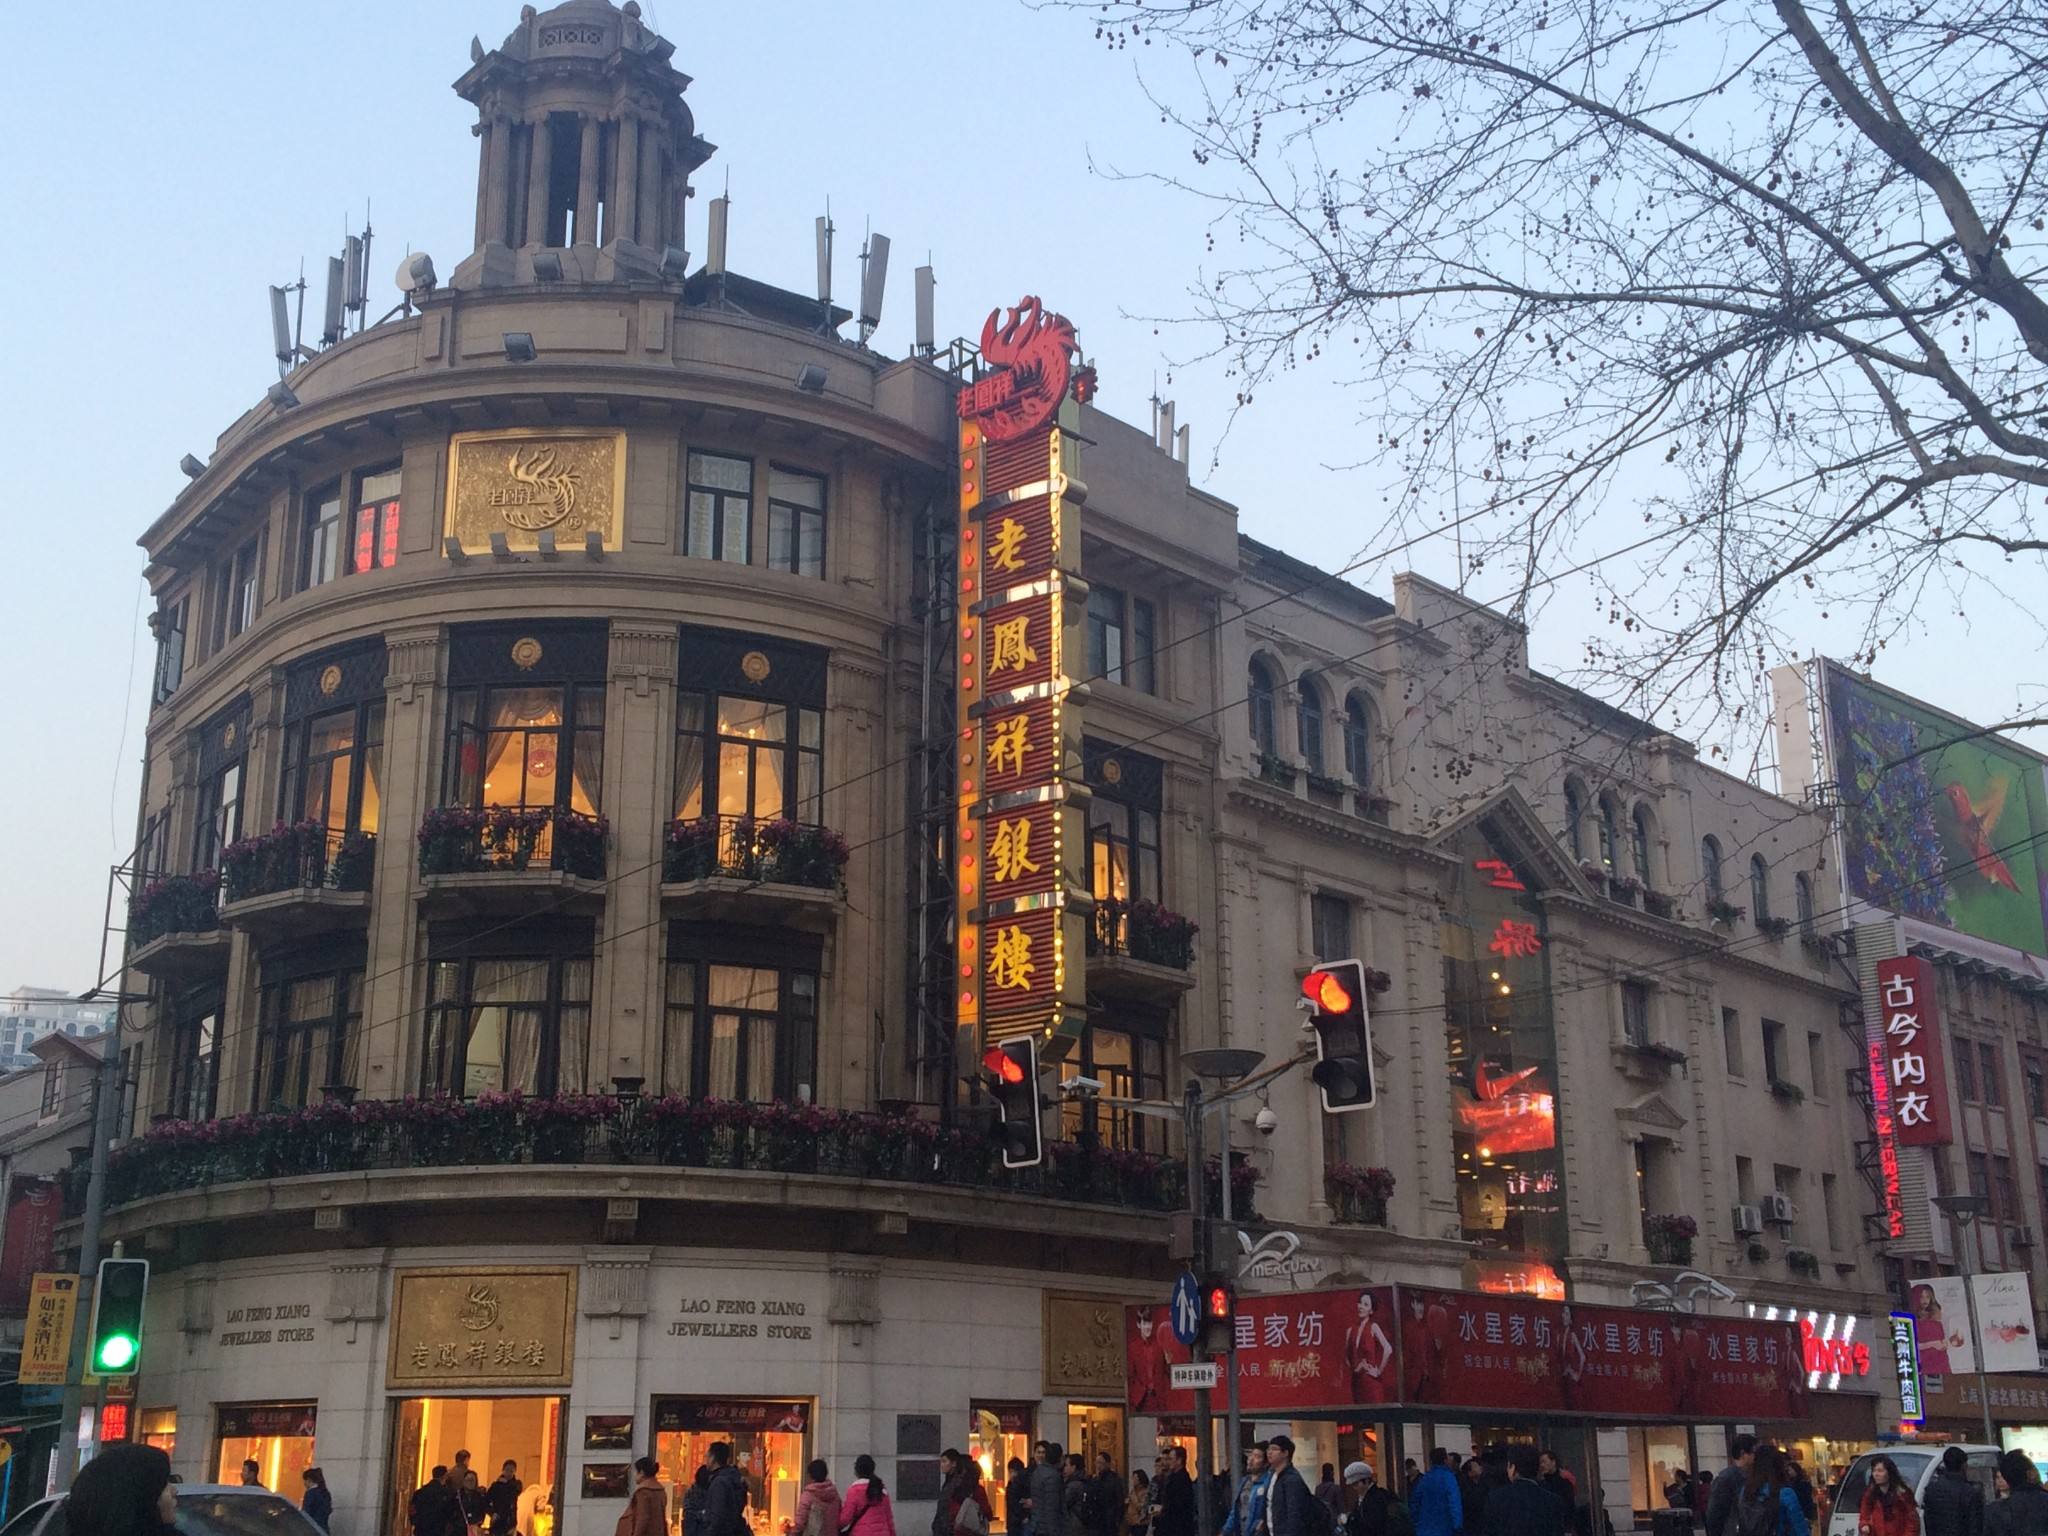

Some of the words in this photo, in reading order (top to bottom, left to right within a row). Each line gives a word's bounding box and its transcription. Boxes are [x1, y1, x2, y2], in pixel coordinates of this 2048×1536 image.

[988, 517, 1040, 992] 老鳳祥銀樓
[1882, 973, 1932, 1127] 古今内衣
[1251, 1257, 1322, 1278] MERCURY
[226, 1310, 244, 1323] LAO
[246, 1307, 272, 1322] FENG
[275, 1304, 311, 1320] XIANG
[680, 1299, 711, 1313] LAO
[715, 1300, 757, 1314] FENG
[761, 1301, 806, 1316] XIANG
[32, 1296, 56, 1362] 如家酒店
[219, 1331, 272, 1346] JEWELLERS
[277, 1328, 315, 1342] STORE
[667, 1322, 759, 1337] JEWELLERS
[767, 1325, 812, 1340] STORE
[1234, 1311, 1325, 1349] 星家纺
[1459, 1310, 1550, 1348] 水星家纺
[1582, 1321, 1663, 1358] 水星家纺
[1706, 1333, 1778, 1366] 水星家纺
[1894, 1322, 1917, 1414] 兰州牛肉面
